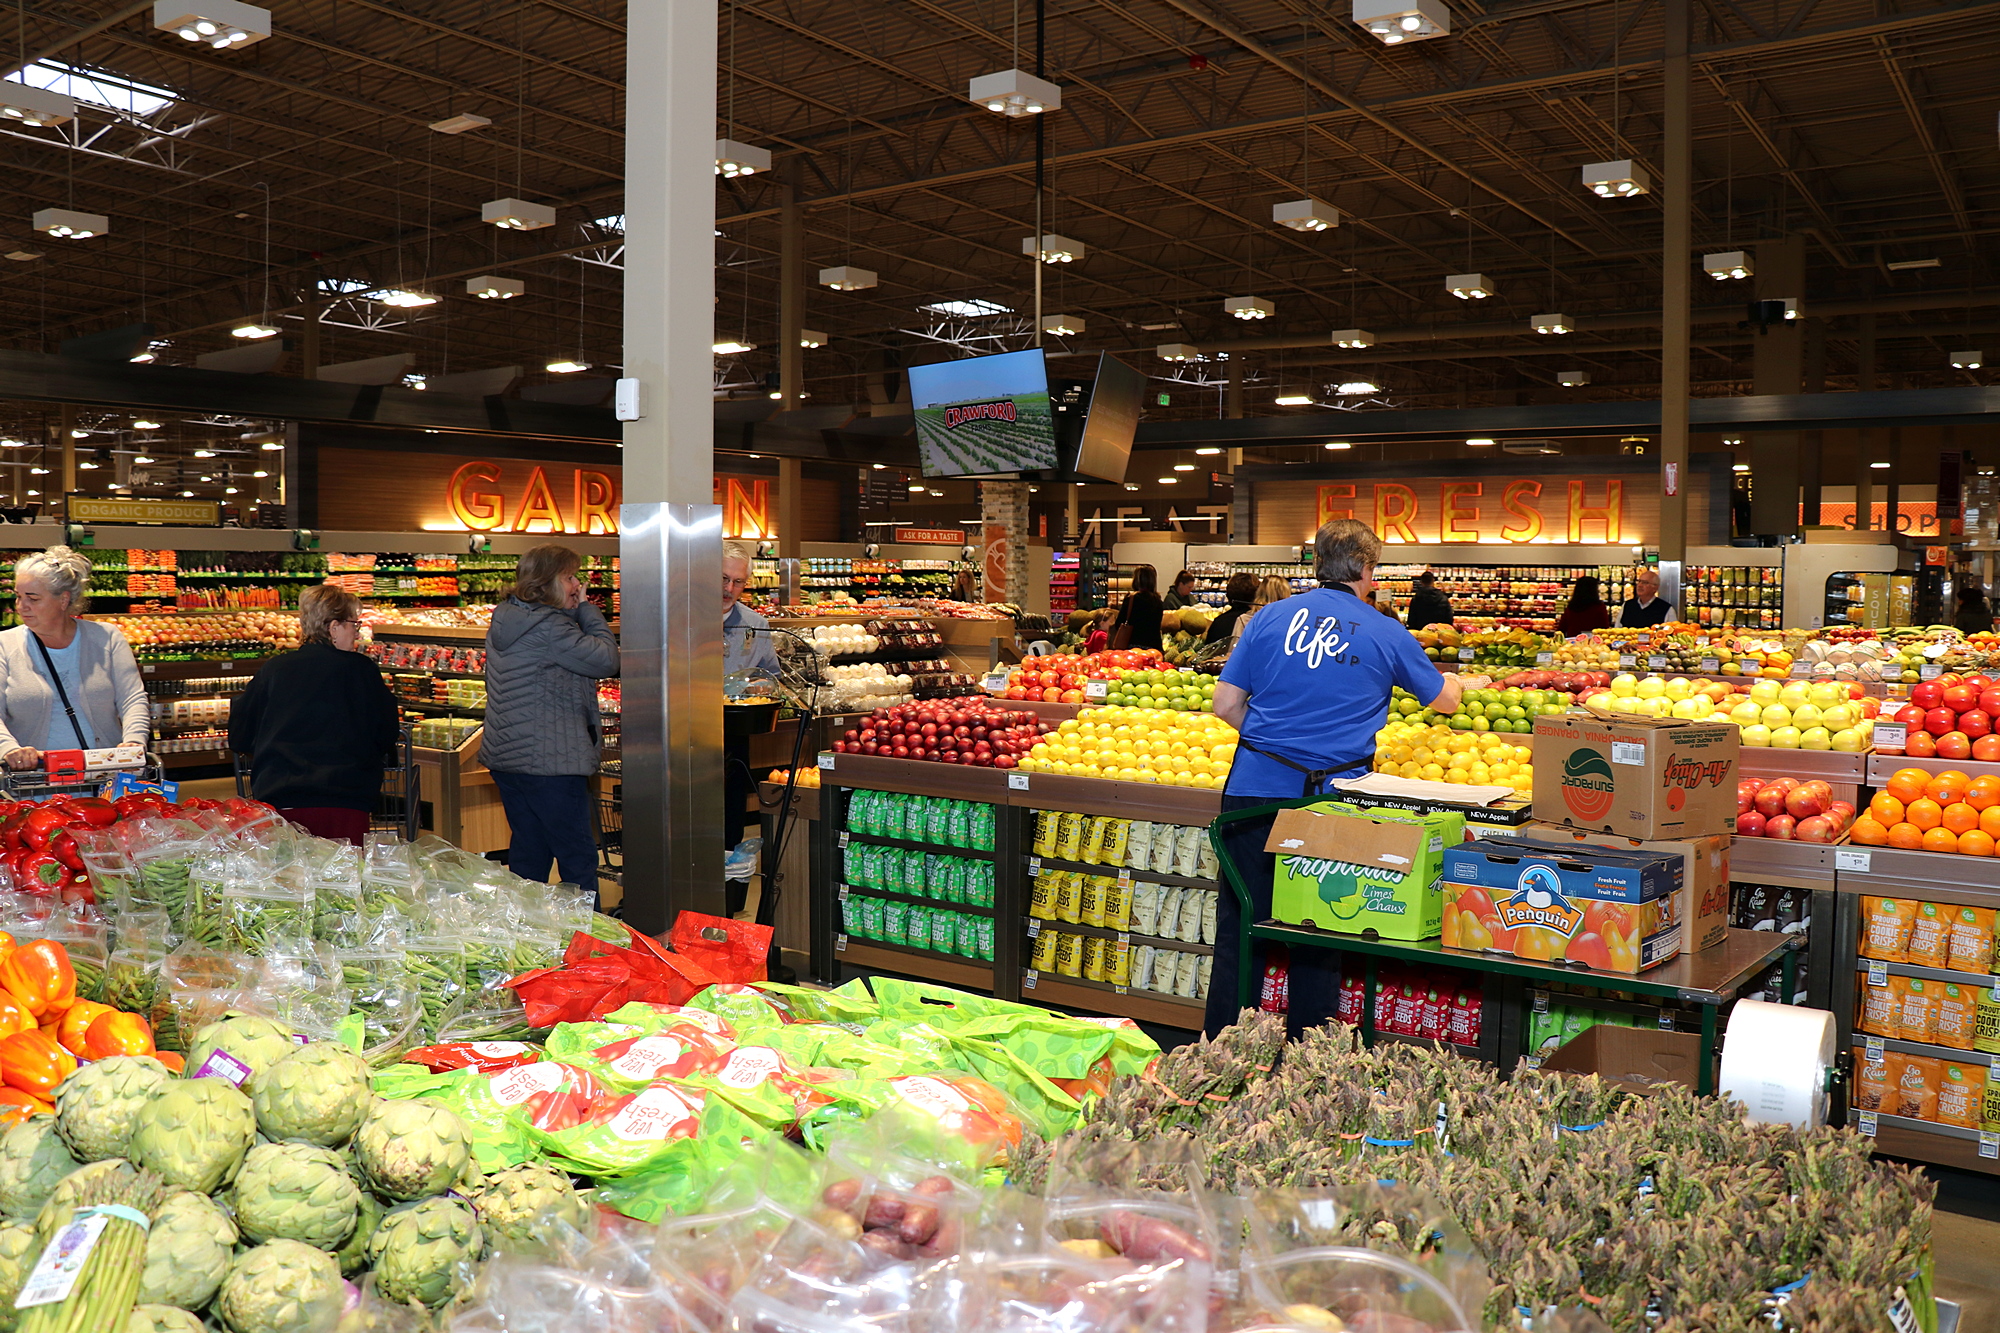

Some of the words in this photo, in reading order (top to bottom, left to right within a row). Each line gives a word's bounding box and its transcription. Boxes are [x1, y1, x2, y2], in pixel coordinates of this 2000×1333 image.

[944, 401, 1017, 429] CRAWFORD
[446, 461, 770, 538] GARN
[80, 504, 143, 516] ORGANIC
[148, 506, 209, 518] PRODUCE
[1315, 479, 1623, 543] FRESH
[903, 531, 916, 540] ASK
[918, 531, 933, 540] FOR
[933, 532, 939, 540] A
[939, 532, 959, 541] TASTE
[1314, 614, 1361, 636] EAT
[1284, 607, 1350, 670] life
[1334, 652, 1361, 667] UP
[1536, 725, 1580, 739] ORANGES
[1343, 797, 1359, 805] NEW
[1360, 798, 1379, 807] Apple!
[1384, 801, 1402, 809] NEW
[1402, 802, 1421, 811] Apple!
[1470, 811, 1487, 820] NEW
[1488, 813, 1509, 822] Apple!
[1594, 882, 1611, 890] Fruta
[1598, 876, 1613, 884] Fresh
[1613, 877, 1627, 885] Fruit
[1361, 884, 1395, 900] Limes
[1597, 888, 1612, 896] Fruit
[1612, 890, 1627, 898] Frais
[1366, 898, 1407, 914] Chaux
[1749, 898, 1767, 910] Raw
[1506, 908, 1570, 931] Penguin
[1872, 915, 1901, 925] SPROUTED
[1871, 925, 1899, 937] COOKIE
[1952, 923, 1981, 935] SPROUTED
[1870, 935, 1897, 948] CRISPS
[1910, 939, 1936, 952] CRISPS
[1950, 934, 1979, 948] COOKIE
[1949, 944, 1977, 958] CRISPS
[1396, 997, 1414, 1007] SPROUTED
[1866, 998, 1892, 1011] COOKIE
[1866, 1008, 1890, 1022] CRISPS
[1903, 1005, 1926, 1017] OOKIE
[1940, 1010, 1962, 1023] OOKIE
[1394, 1012, 1413, 1025] SEEDS
[1902, 1015, 1925, 1027] RISPS
[1939, 1019, 1961, 1034] RISPS
[621, 1057, 644, 1075] veg
[627, 1045, 669, 1074] fresh
[729, 1054, 780, 1079] fresh
[731, 1069, 759, 1083] veg
[1862, 1066, 1887, 1080] Raw
[505, 1066, 548, 1101] fresh
[1901, 1075, 1924, 1088] Raw
[1941, 1082, 1969, 1093] SPROUTED
[500, 1080, 527, 1104] veg
[1939, 1092, 1968, 1106] COOKIE
[627, 1099, 679, 1129] fresh
[1938, 1102, 1966, 1116] CRISPS
[624, 1117, 653, 1136] veg
